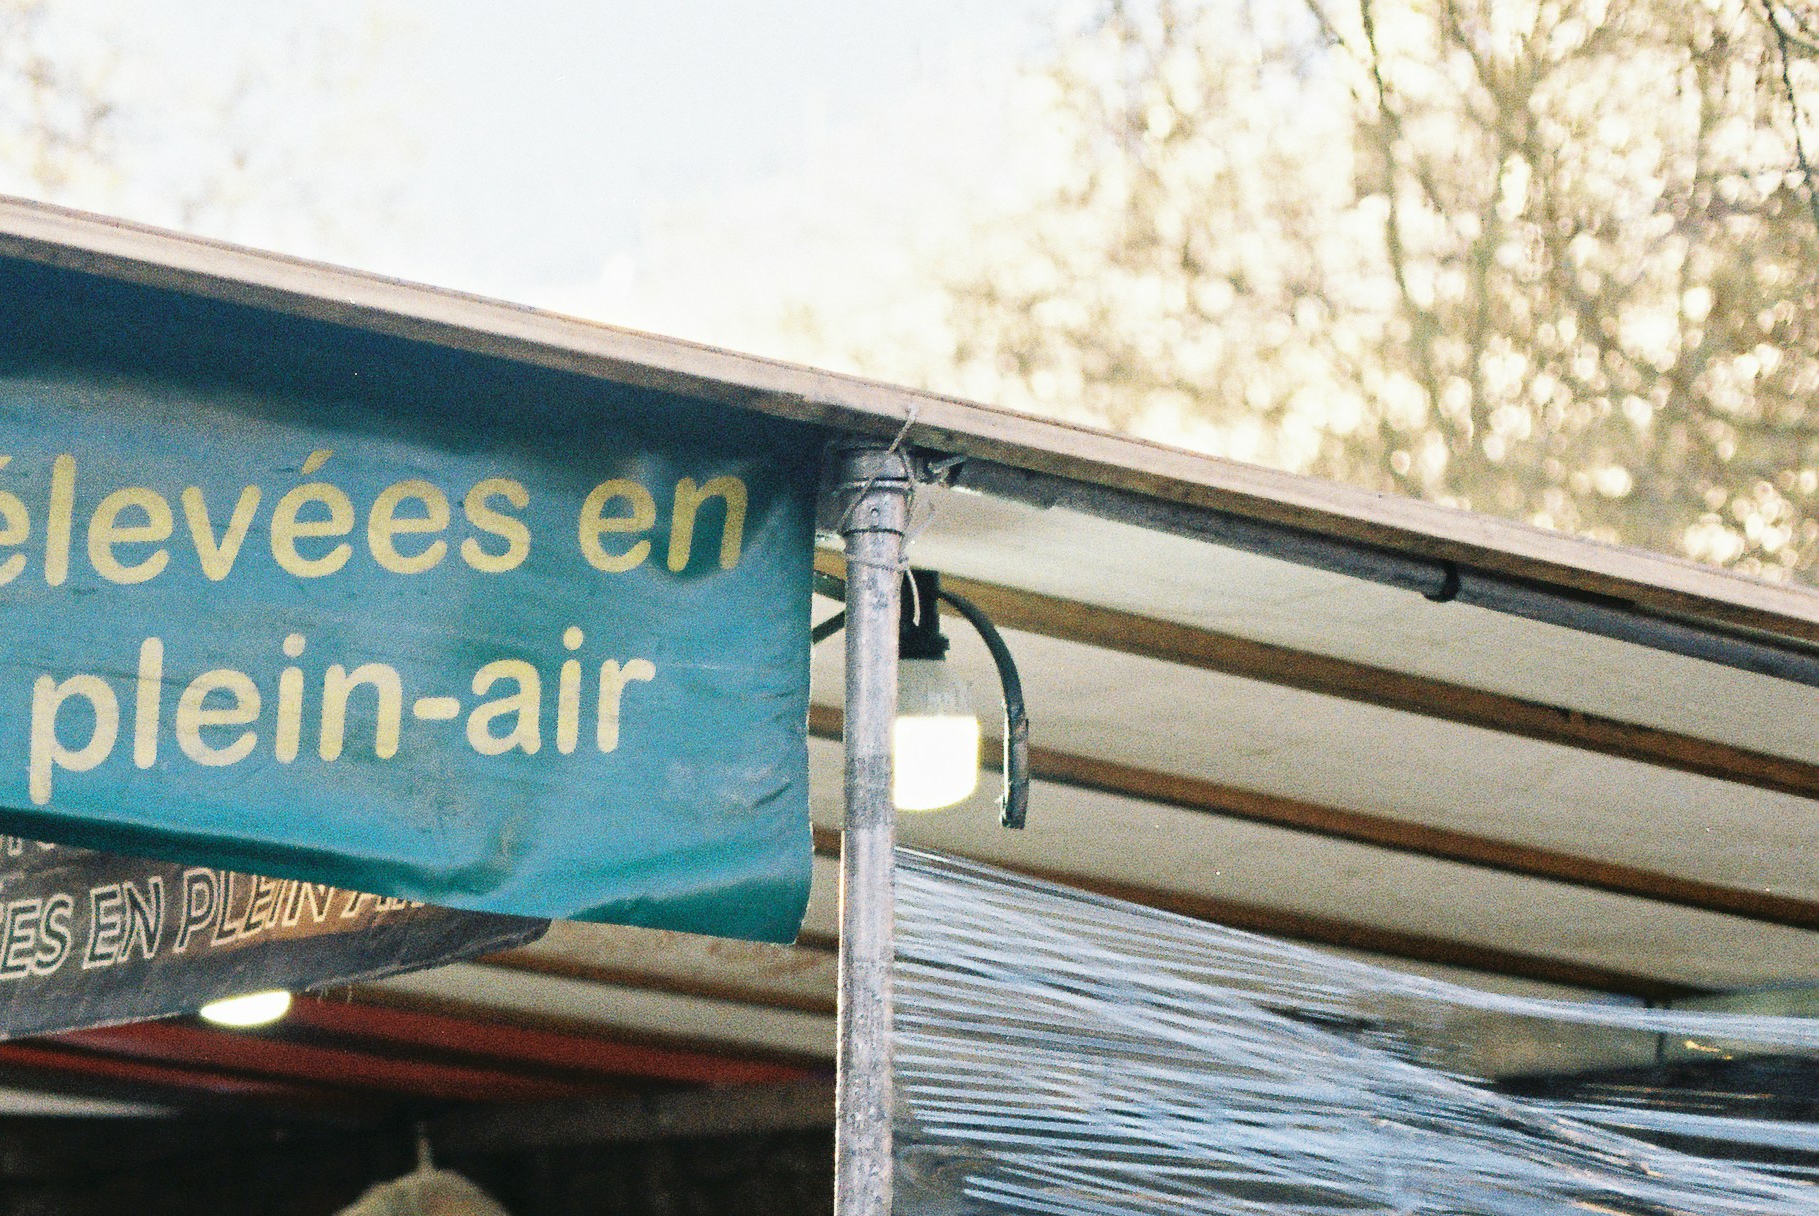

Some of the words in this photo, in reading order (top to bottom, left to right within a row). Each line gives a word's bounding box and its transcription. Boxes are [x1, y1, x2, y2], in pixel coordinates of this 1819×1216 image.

[579, 474, 748, 576] en
[30, 626, 656, 805] plein-air
[83, 876, 166, 970] EN
